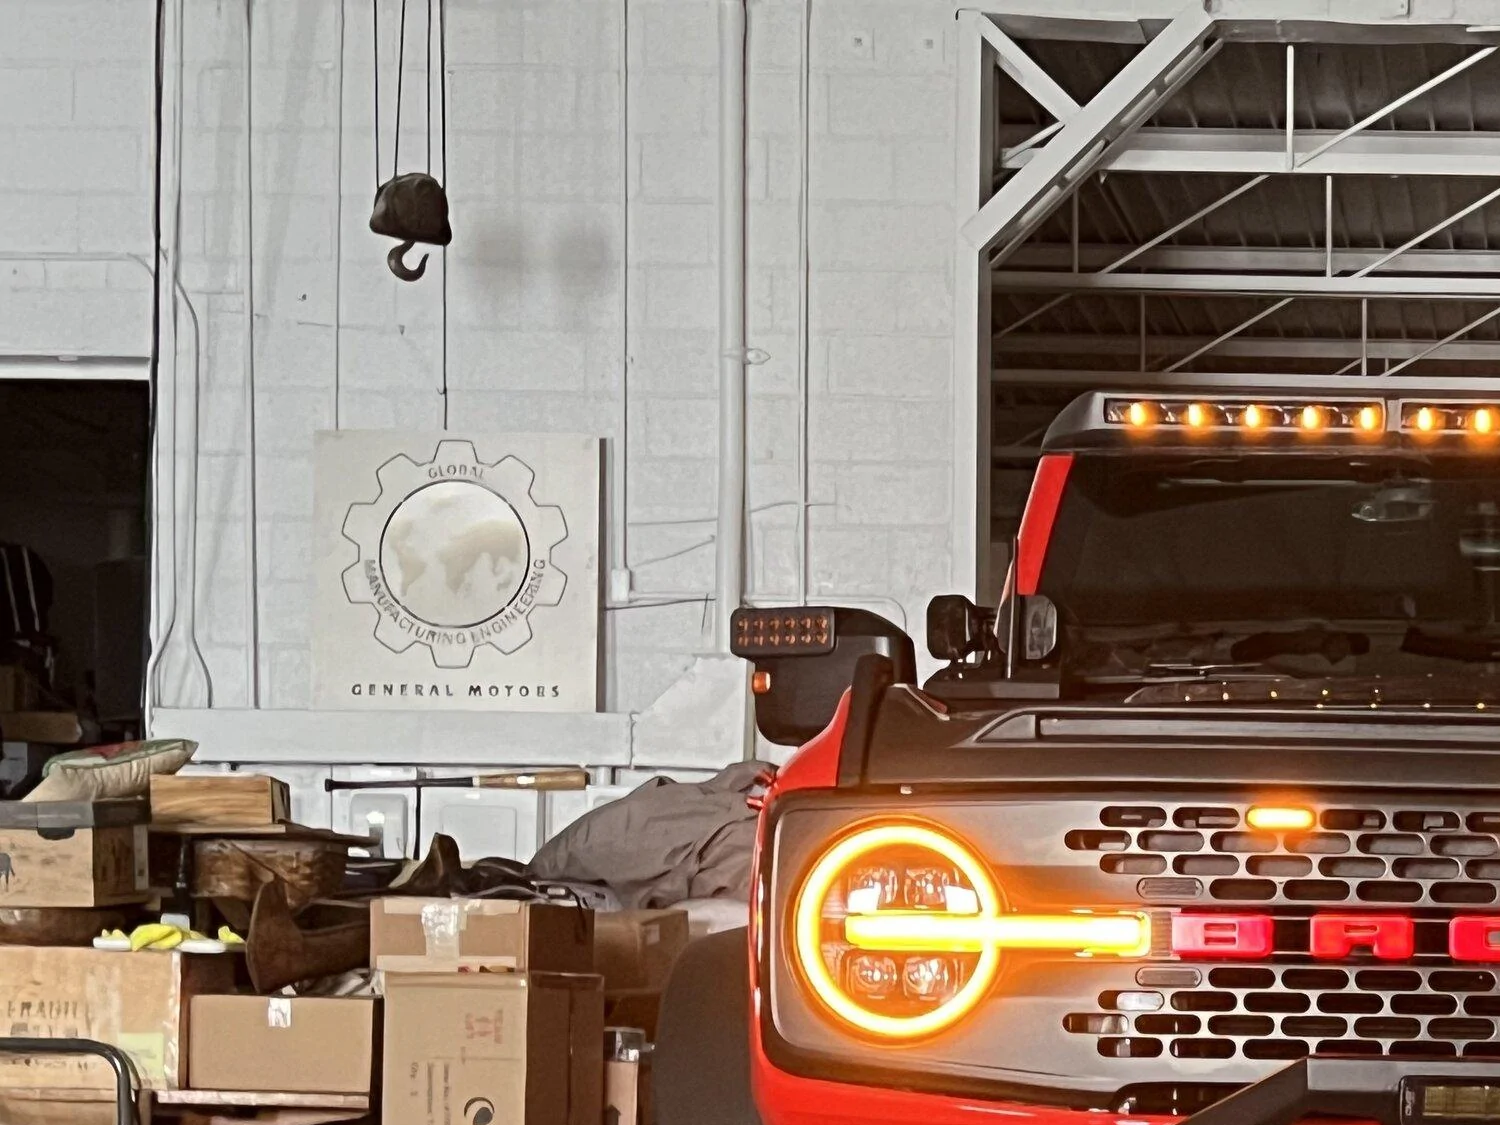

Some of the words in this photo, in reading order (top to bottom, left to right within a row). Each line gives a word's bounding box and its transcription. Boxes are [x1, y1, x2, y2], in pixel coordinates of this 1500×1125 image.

[427, 463, 486, 480] GLOBAL
[363, 558, 467, 645] MANUFACTURING
[470, 558, 547, 644] ENGINEERING
[350, 682, 454, 698] GENERAL
[467, 682, 560, 698] MOTORS
